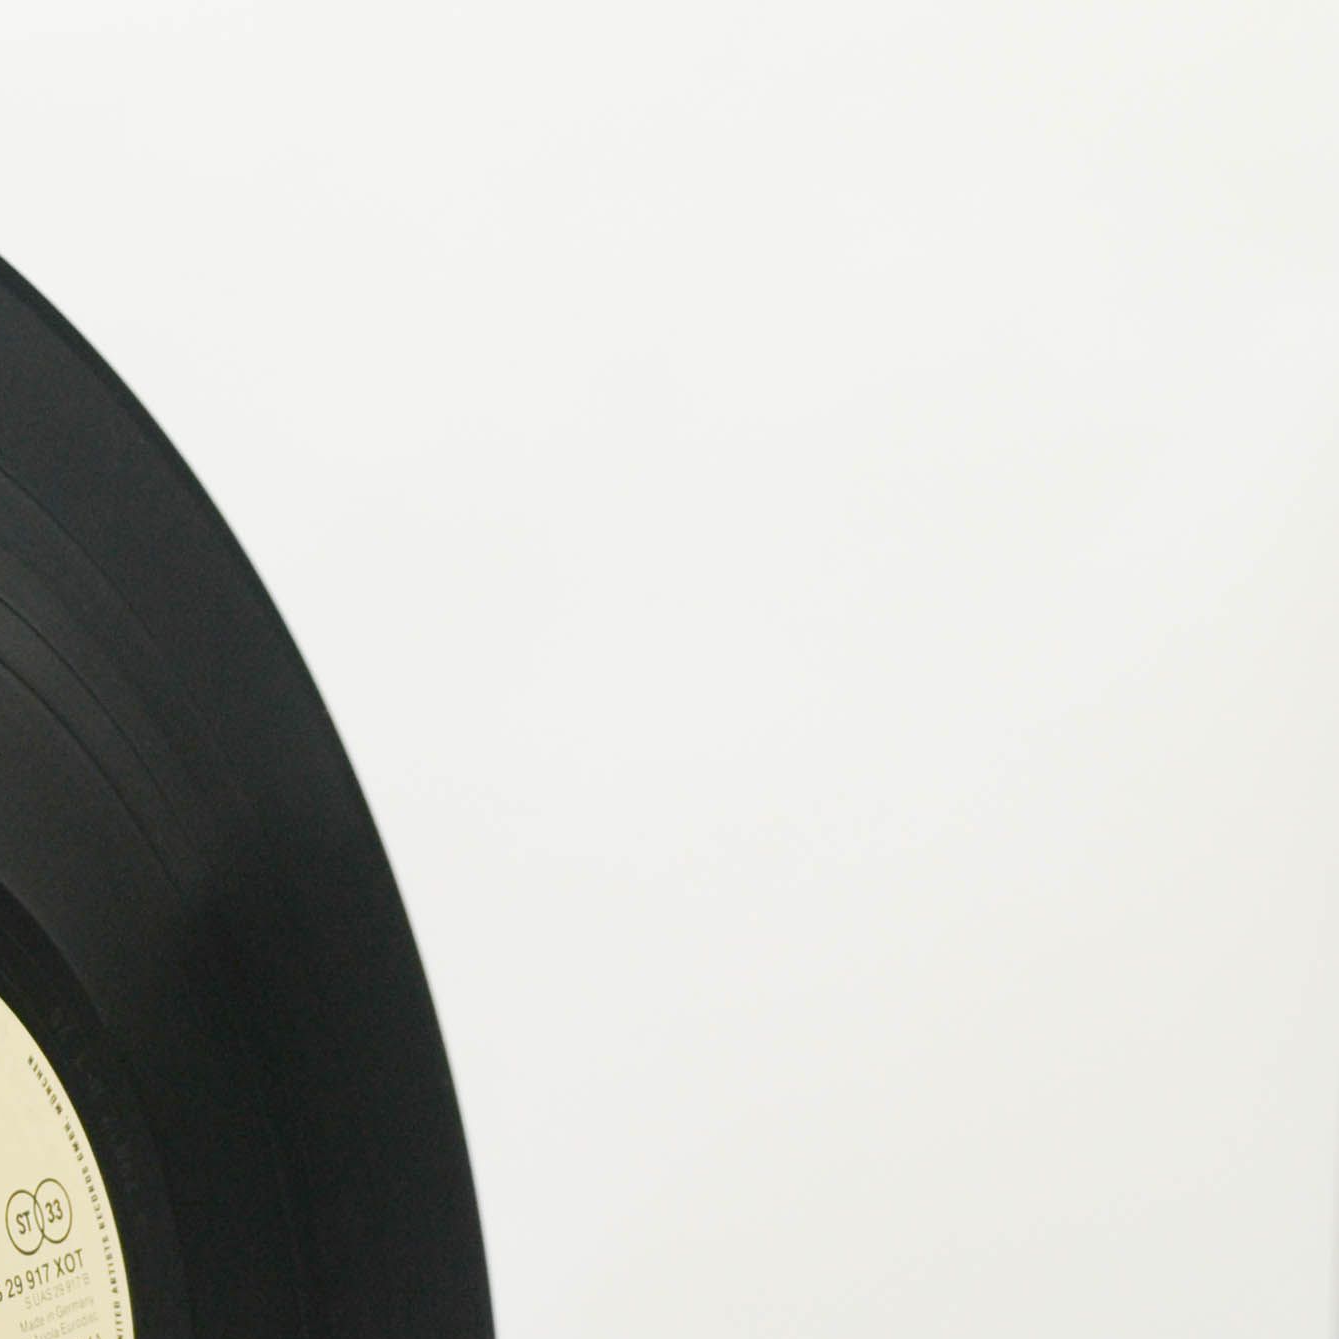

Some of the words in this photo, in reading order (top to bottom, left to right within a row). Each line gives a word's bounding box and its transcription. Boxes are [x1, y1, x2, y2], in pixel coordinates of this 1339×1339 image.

[16, 1211, 32, 1235] ST
[45, 1199, 63, 1223] 33
[5, 1275, 23, 1298] 29
[26, 1263, 50, 1290] 917
[53, 1248, 84, 1279] XOT
